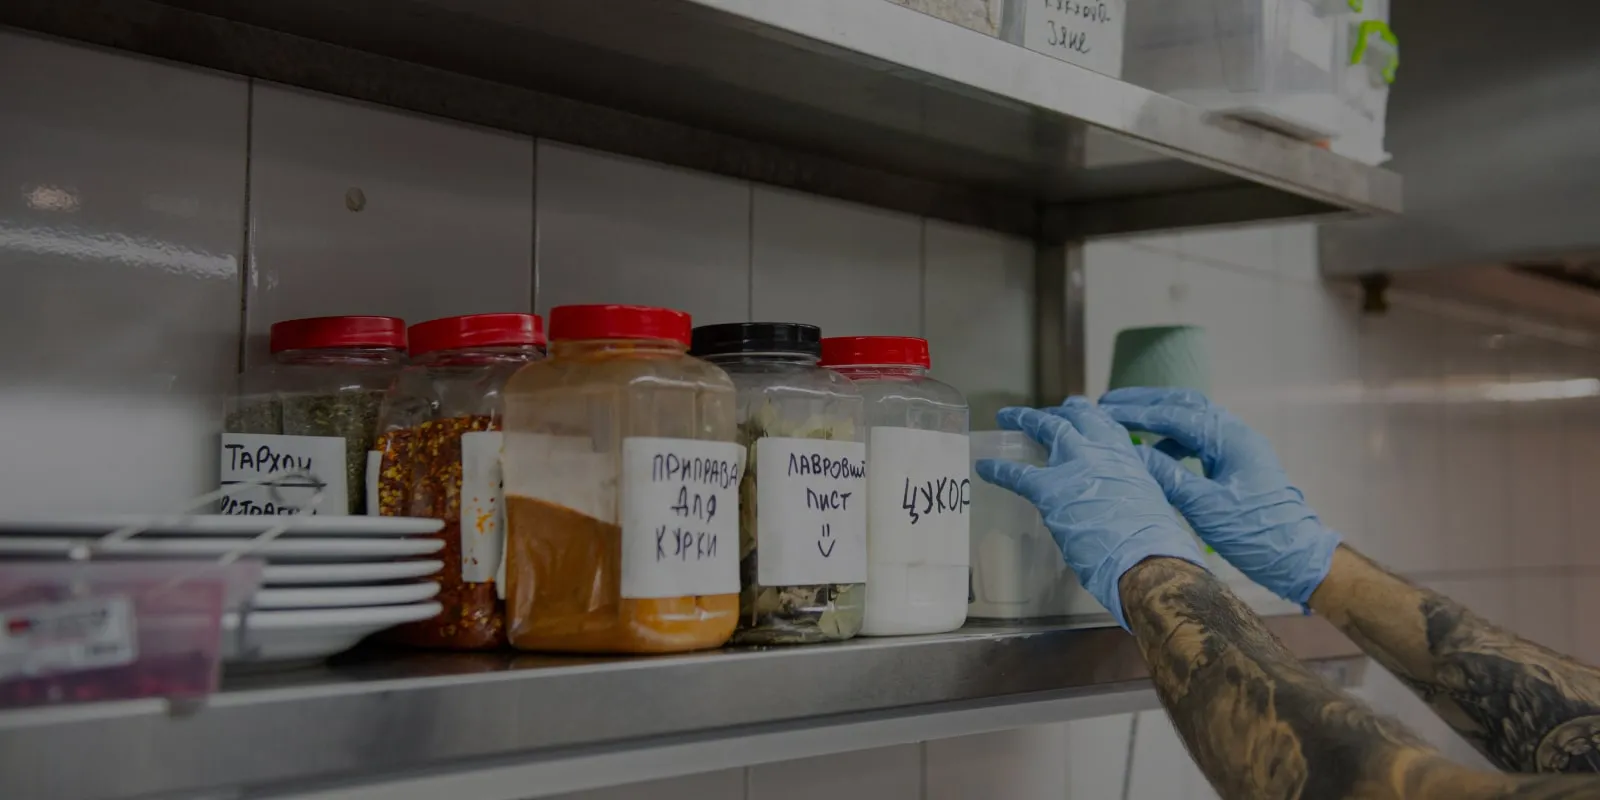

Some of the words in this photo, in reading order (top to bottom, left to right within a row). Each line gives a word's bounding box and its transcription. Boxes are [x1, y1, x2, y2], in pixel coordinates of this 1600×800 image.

[652, 453, 738, 489] ПРИПРАВА
[902, 477, 971, 525] ЦУКОР
[655, 524, 717, 562] КУРКИ
